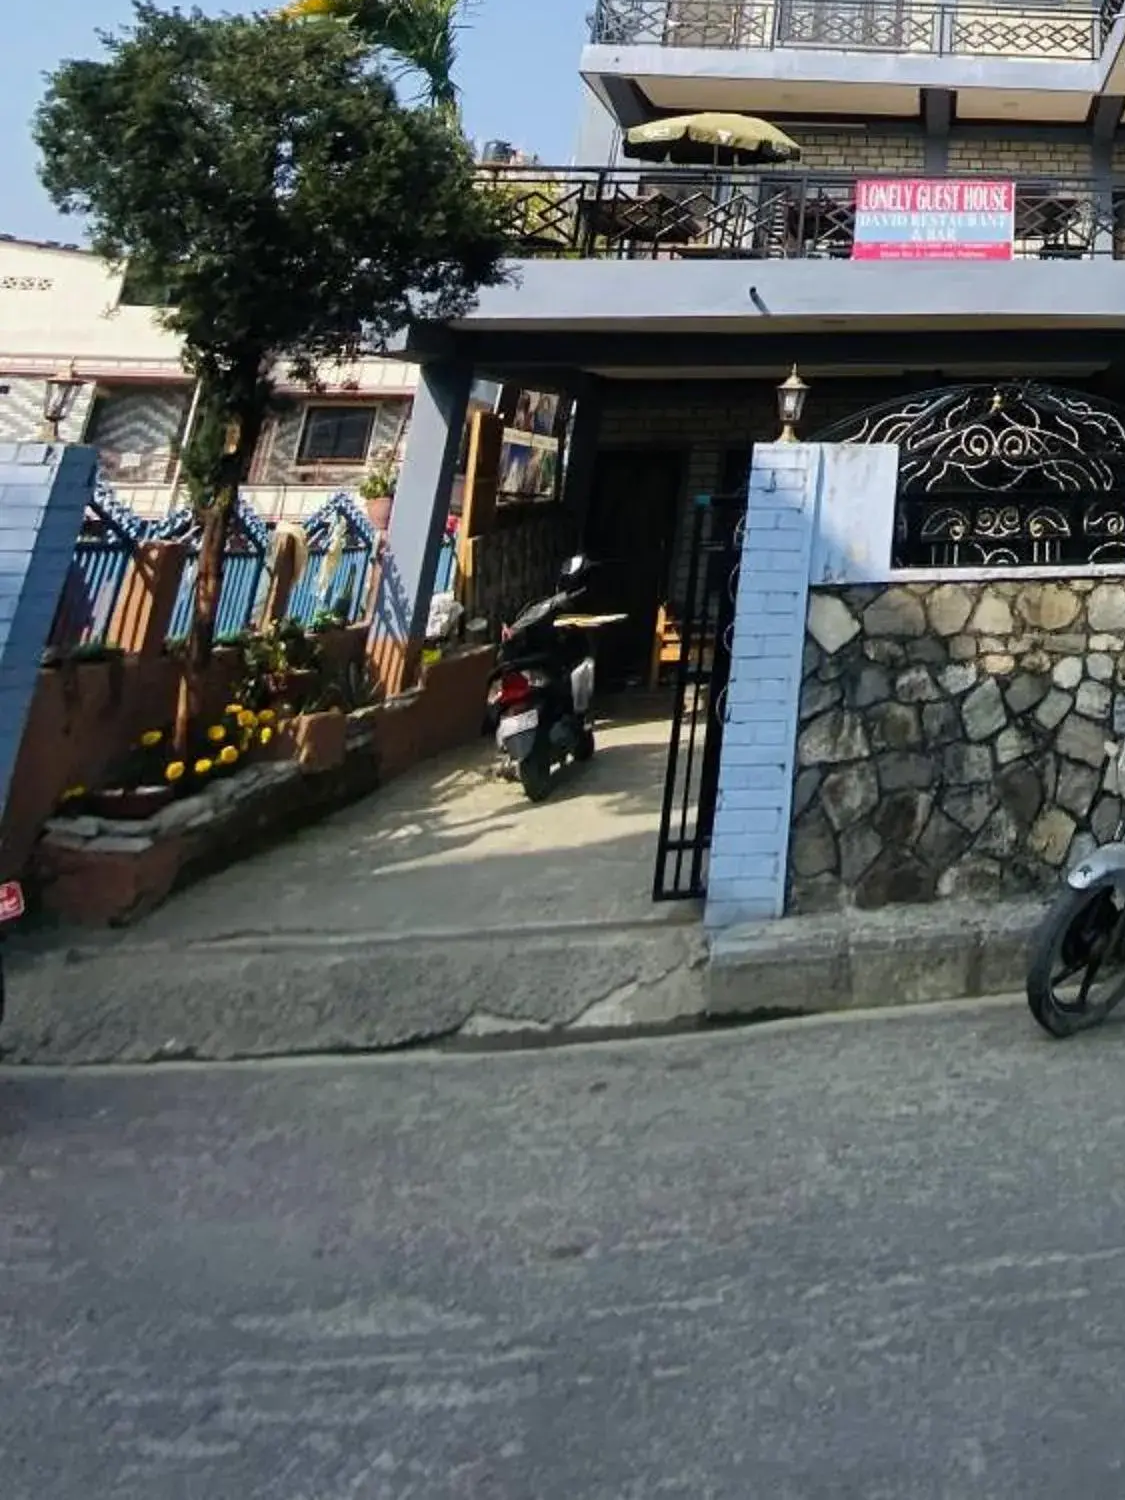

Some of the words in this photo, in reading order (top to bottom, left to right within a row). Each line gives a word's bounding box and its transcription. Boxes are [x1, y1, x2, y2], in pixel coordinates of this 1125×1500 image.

[862, 185, 913, 211] LONELY
[917, 185, 961, 211] GUEST
[964, 185, 1009, 211] HOUSE
